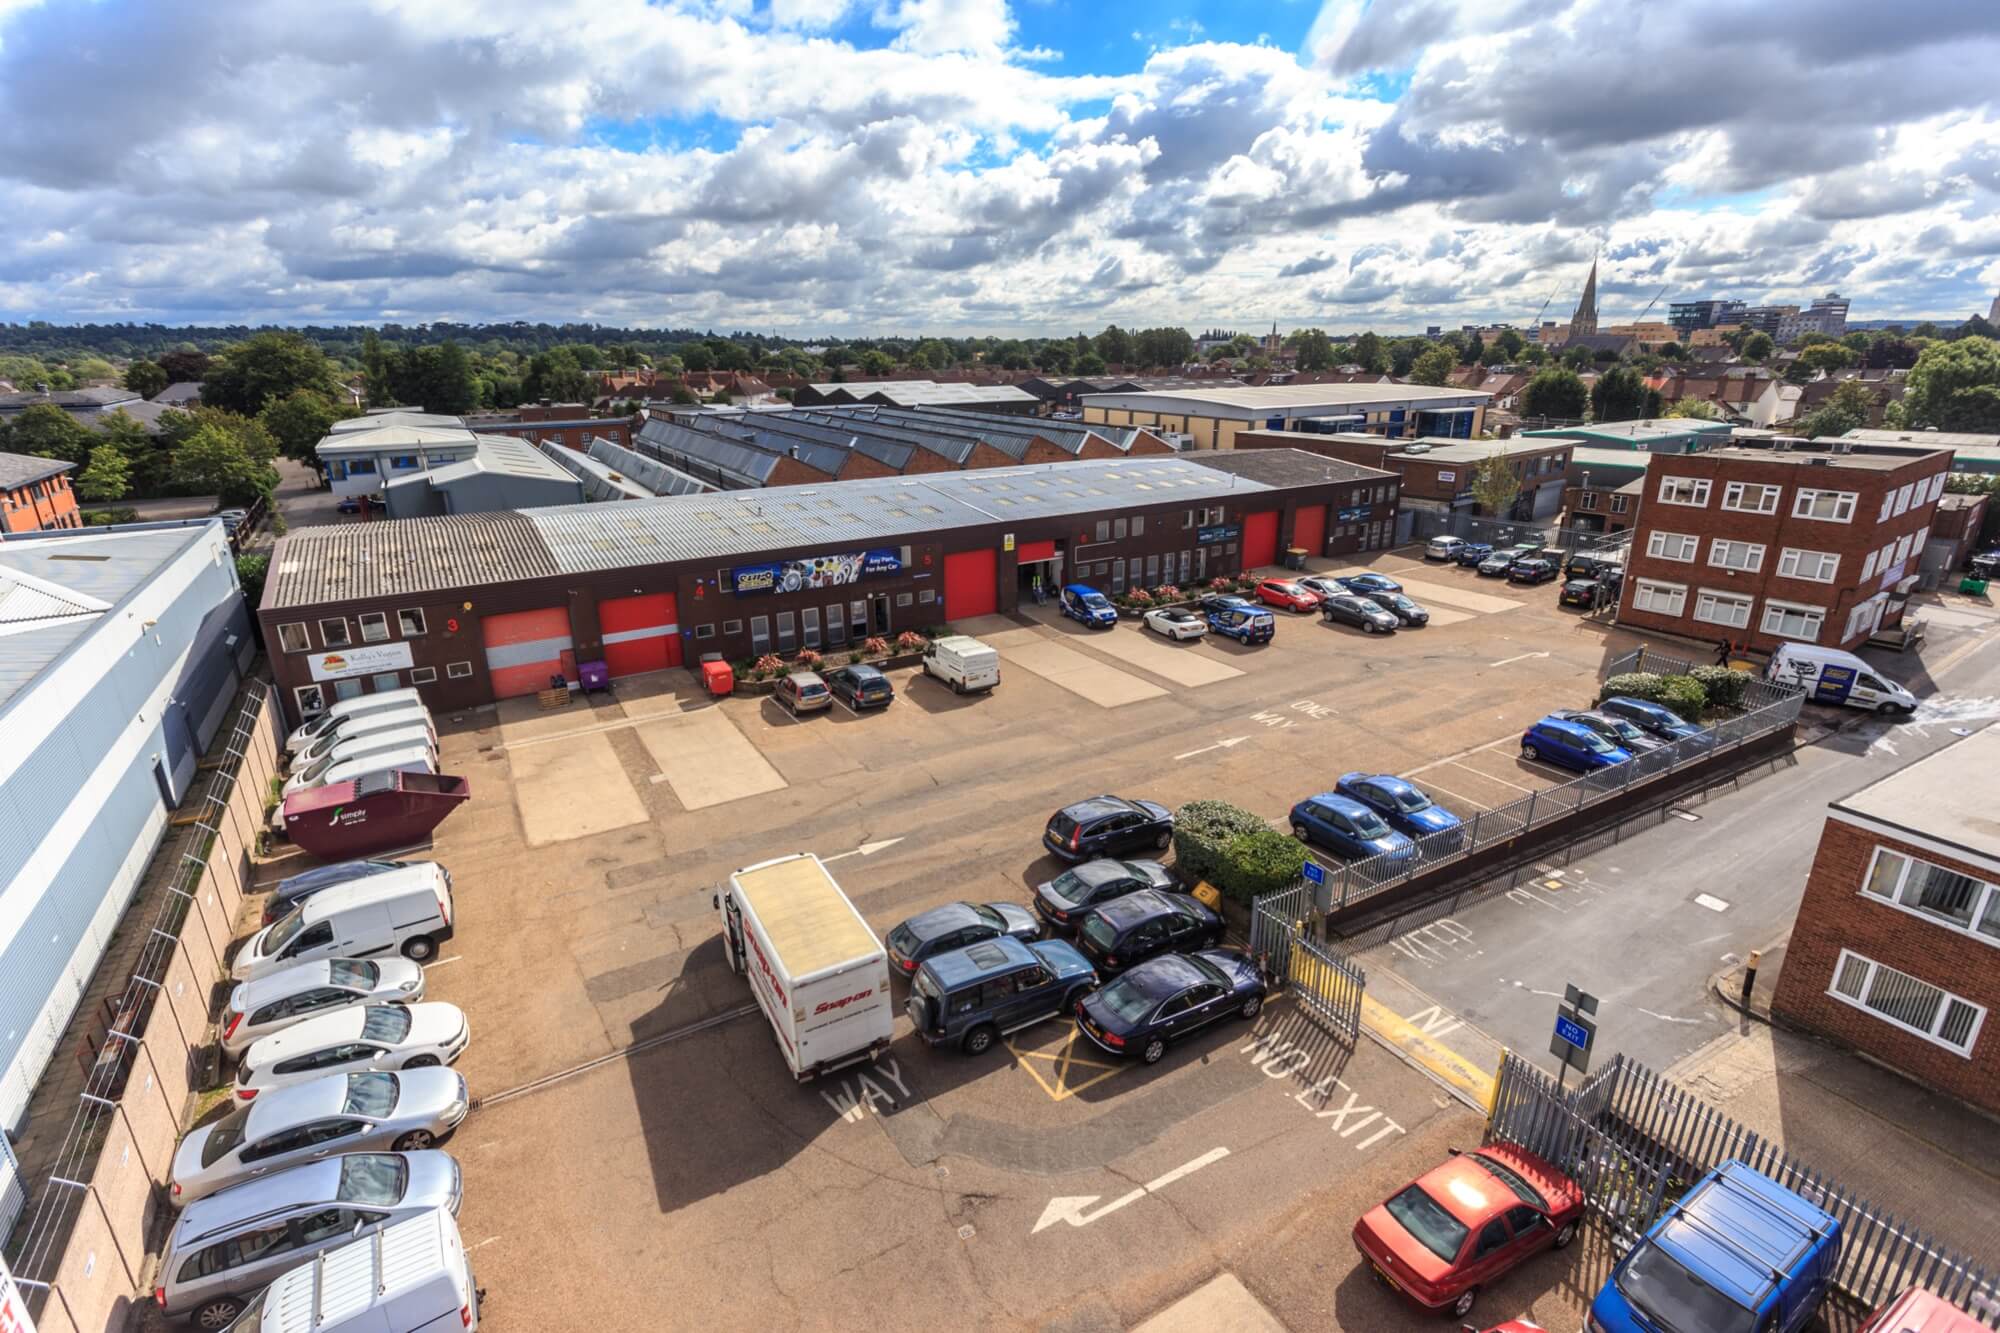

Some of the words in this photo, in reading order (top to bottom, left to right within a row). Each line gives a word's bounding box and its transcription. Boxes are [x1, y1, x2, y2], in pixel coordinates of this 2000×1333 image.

[695, 585, 704, 597] 4
[447, 618, 459, 632] 3
[1291, 701, 1339, 719] ONE
[1249, 711, 1299, 729] WAY
[814, 988, 873, 1016] Snap-on
[1561, 1028, 1580, 1042] EXIT
[1565, 1023, 1579, 1035] NO
[820, 1058, 911, 1123] WAY
[1240, 1030, 1311, 1079] NO
[1298, 1077, 1406, 1151] EXIT
